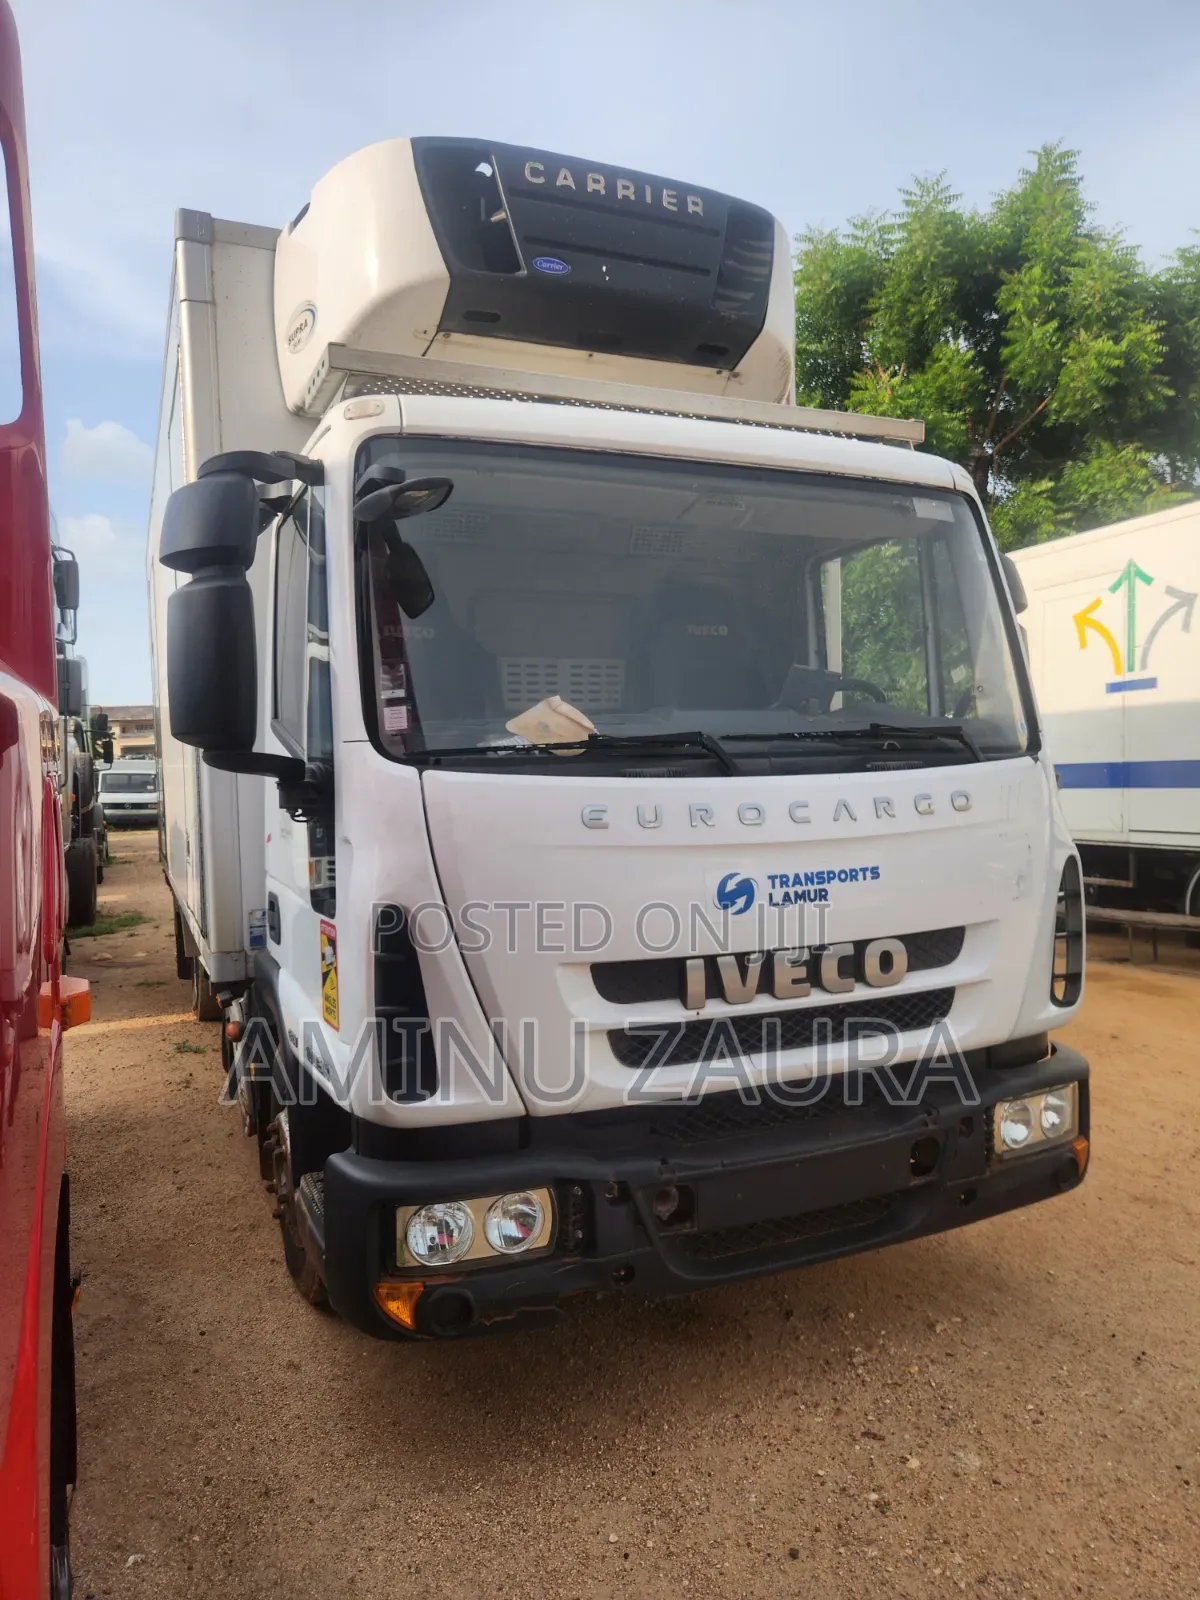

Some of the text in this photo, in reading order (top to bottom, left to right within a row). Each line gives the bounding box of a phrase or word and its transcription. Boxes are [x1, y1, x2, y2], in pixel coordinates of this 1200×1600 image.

[524, 161, 704, 217] CARRIER
[537, 259, 564, 271] Carrier
[581, 789, 974, 830] EUROCARGO
[767, 865, 881, 890] TRANSPORTS
[768, 887, 829, 907] LAMUR
[684, 937, 909, 1010] IVECO
